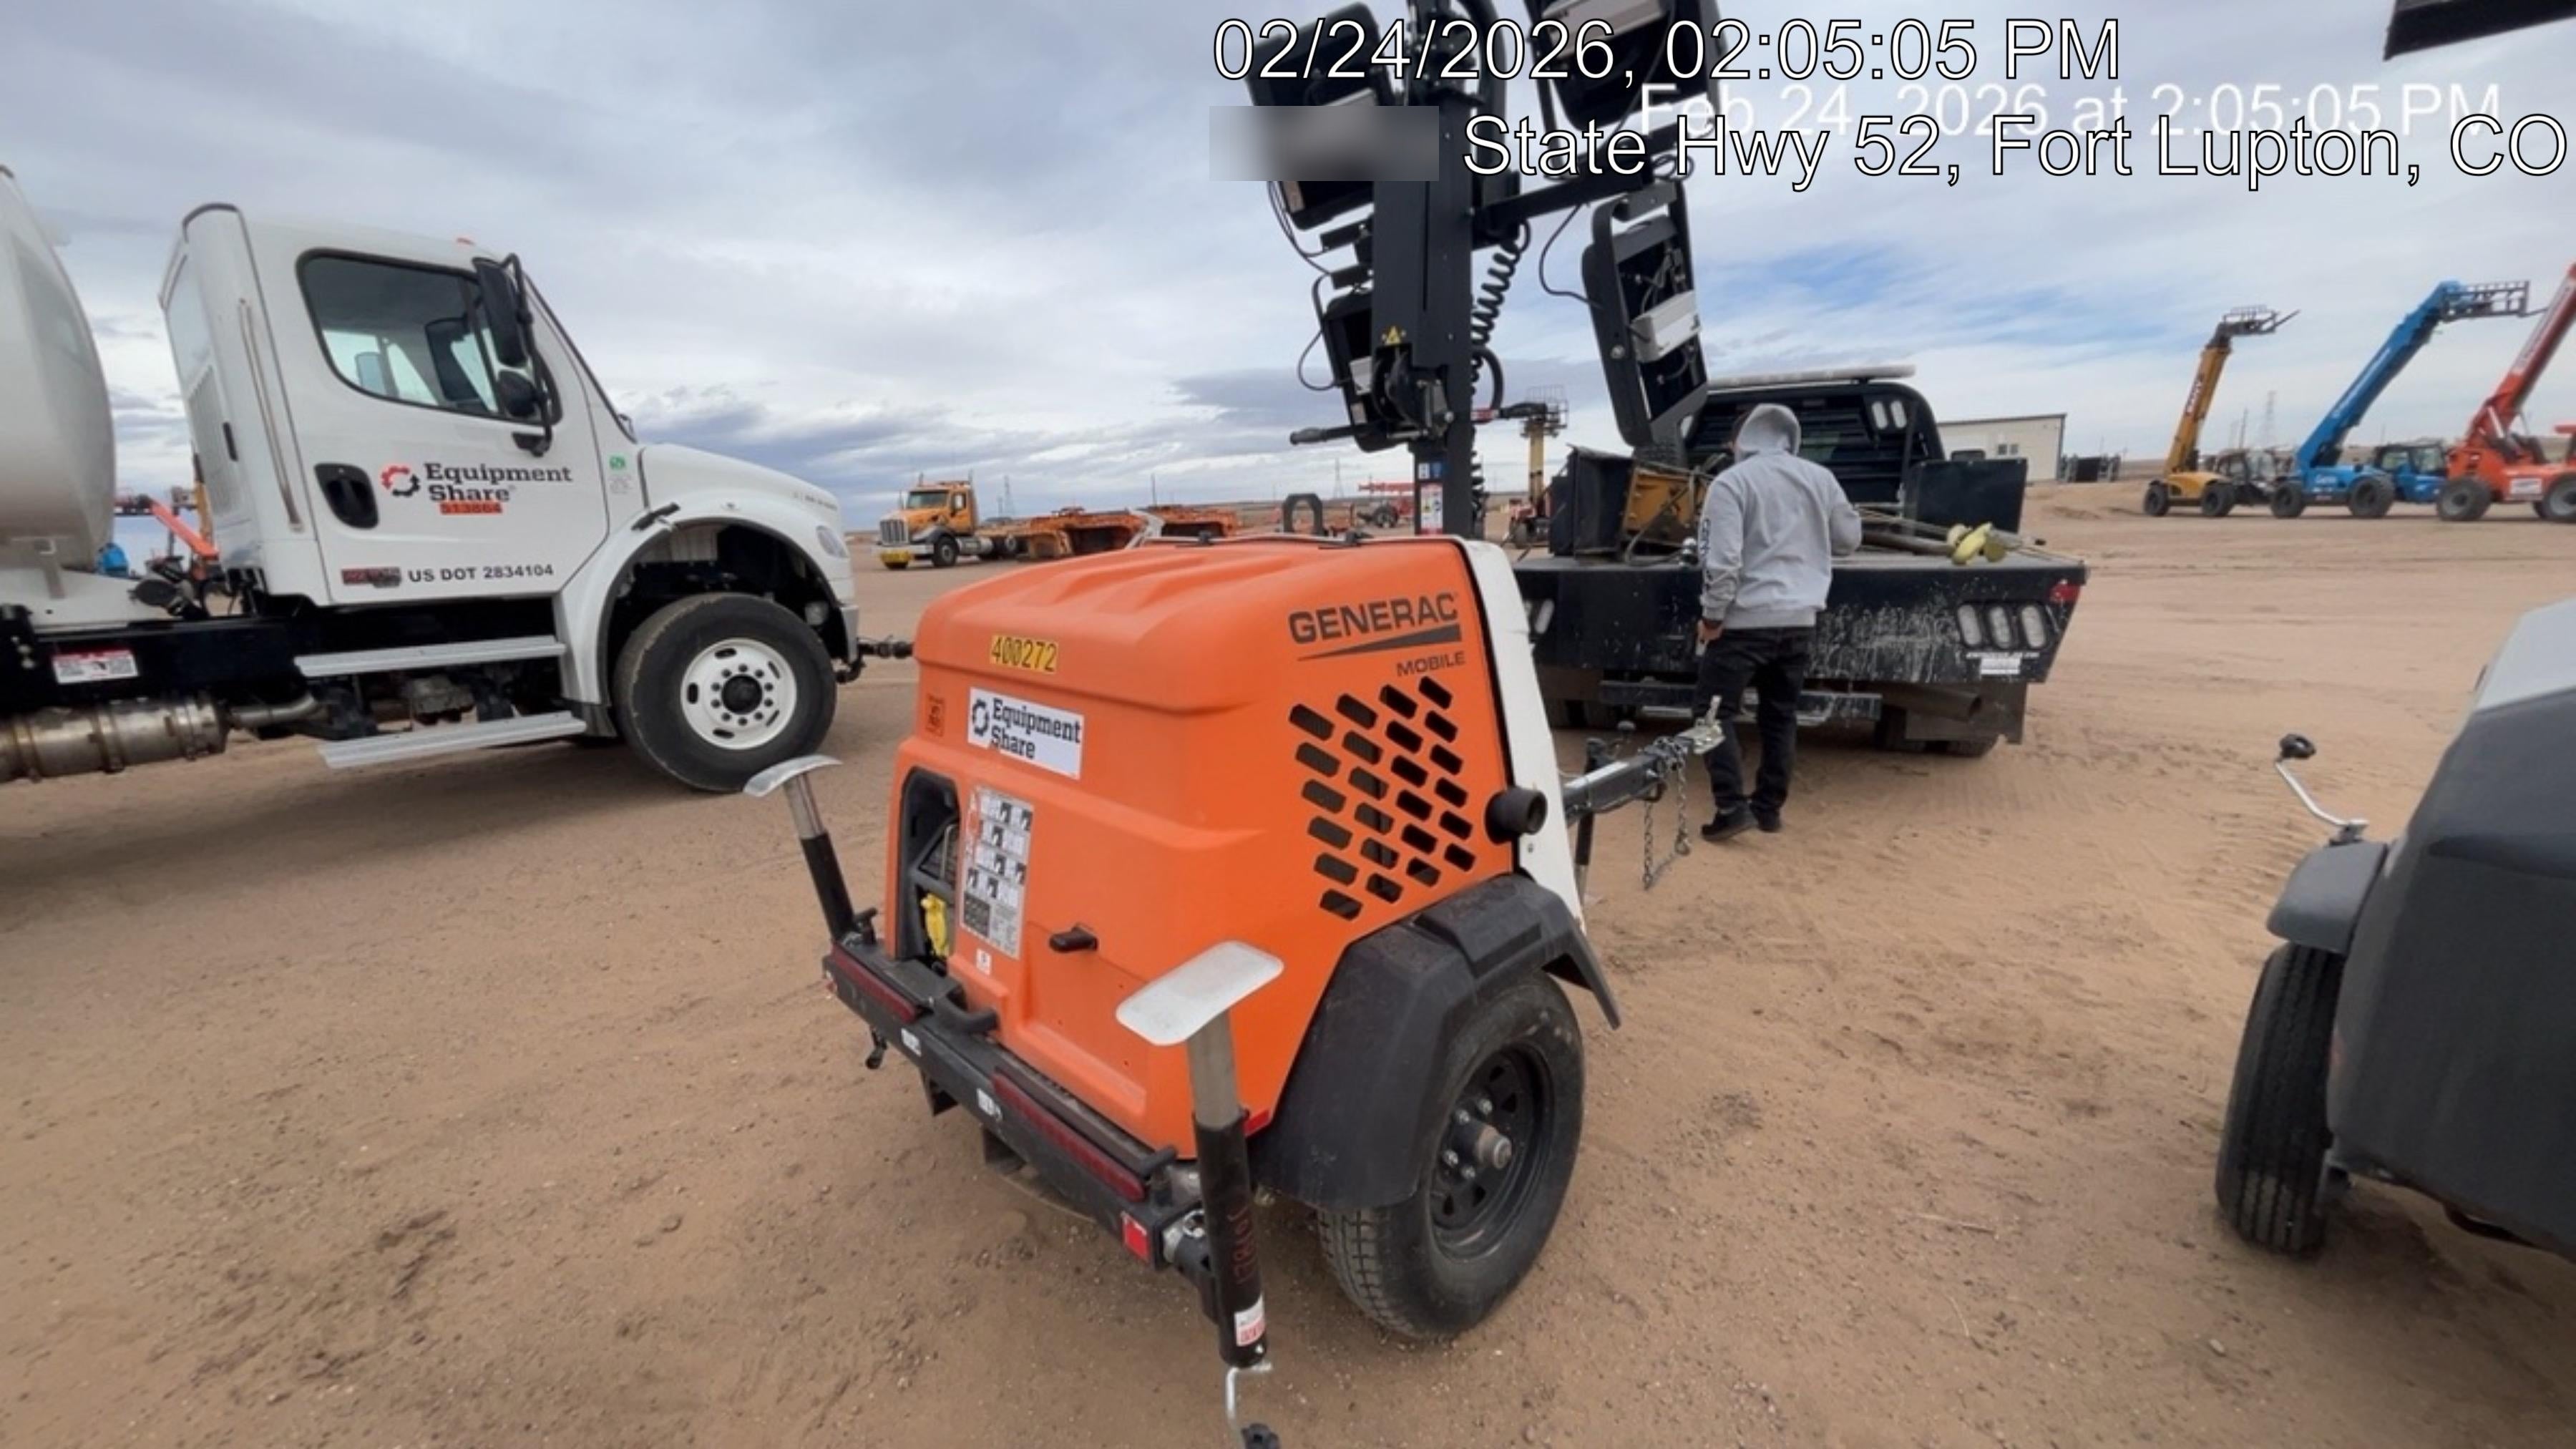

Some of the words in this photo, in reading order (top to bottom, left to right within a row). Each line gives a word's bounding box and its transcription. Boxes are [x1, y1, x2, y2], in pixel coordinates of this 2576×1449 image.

[424, 462, 574, 485] Equipment
[429, 484, 510, 502] Share
[408, 570, 435, 582] US
[440, 567, 477, 581] DOT
[482, 564, 555, 579] 2834104
[1289, 592, 1458, 644] GENERAC
[991, 636, 1058, 673] 400272
[1397, 650, 1466, 677] MOBILE
[992, 697, 1081, 743] Equipment
[990, 724, 1036, 759] Share
